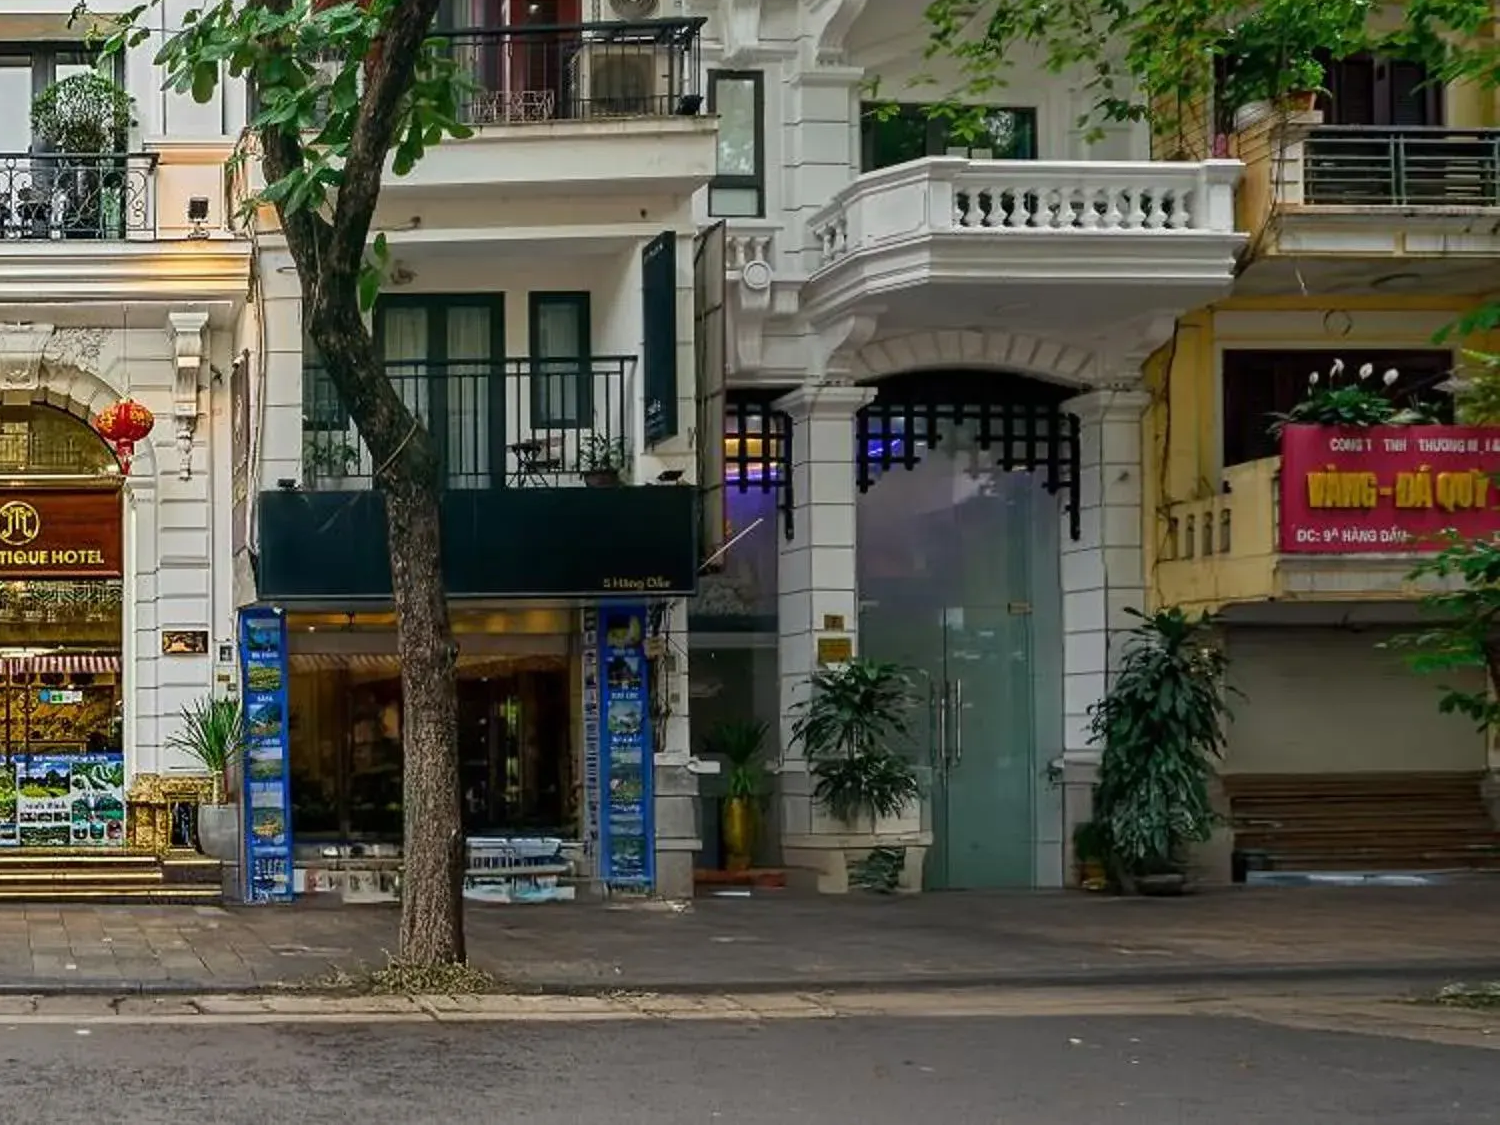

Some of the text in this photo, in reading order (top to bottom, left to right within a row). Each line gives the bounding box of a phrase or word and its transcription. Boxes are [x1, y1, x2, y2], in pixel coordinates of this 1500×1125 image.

[1307, 463, 1378, 508] VÀNG
[1341, 527, 1377, 543] HÀNG
[51, 549, 105, 564] HOTEL
